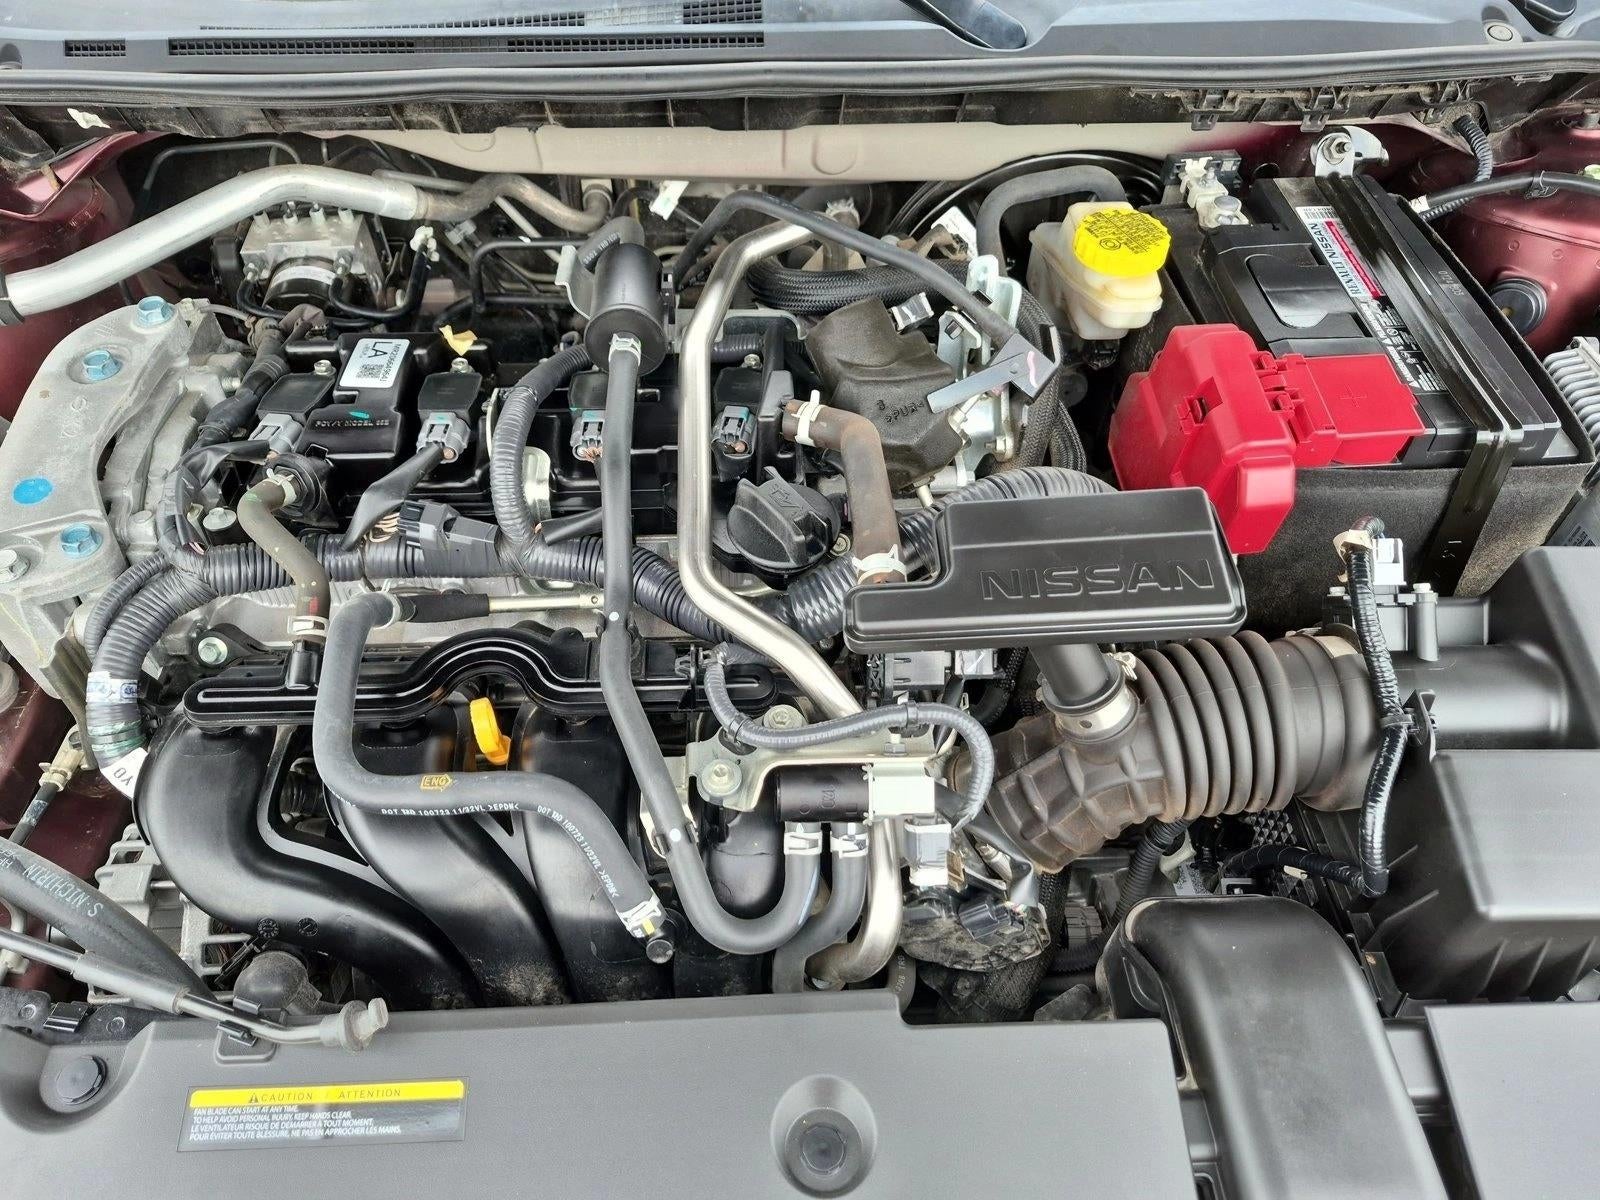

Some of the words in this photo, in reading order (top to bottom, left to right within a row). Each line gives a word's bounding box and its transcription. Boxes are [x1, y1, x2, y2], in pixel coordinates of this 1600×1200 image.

[1309, 222, 1339, 259] NISSAN
[368, 341, 393, 358] LA
[980, 559, 1215, 600] NISSAN
[423, 775, 446, 787] ENG
[537, 804, 552, 815] DOT
[261, 1092, 313, 1102] CAUTION
[338, 1089, 401, 1099] ATTENTION
[206, 1106, 228, 1115] BLADE
[227, 1106, 241, 1115] CAN
[241, 1105, 262, 1114] START
[193, 1116, 203, 1124] TO
[202, 1116, 219, 1124] HELP
[219, 1114, 240, 1123] AVOID
[240, 1113, 271, 1123] PERSONAL
[309, 1111, 330, 1120] HANDS
[191, 1124, 202, 1133] LE
[202, 1122, 244, 1132] VENTILATEUR
[244, 1121, 269, 1131] RISQUE
[269, 1121, 280, 1130] DE
[323, 1118, 341, 1128] TOUT
[190, 1132, 209, 1141] POUR
[233, 1130, 256, 1139] TOUTE
[290, 1128, 302, 1137] NE
[301, 1127, 316, 1137] PAS
[325, 1126, 367, 1137] APPROCHER
